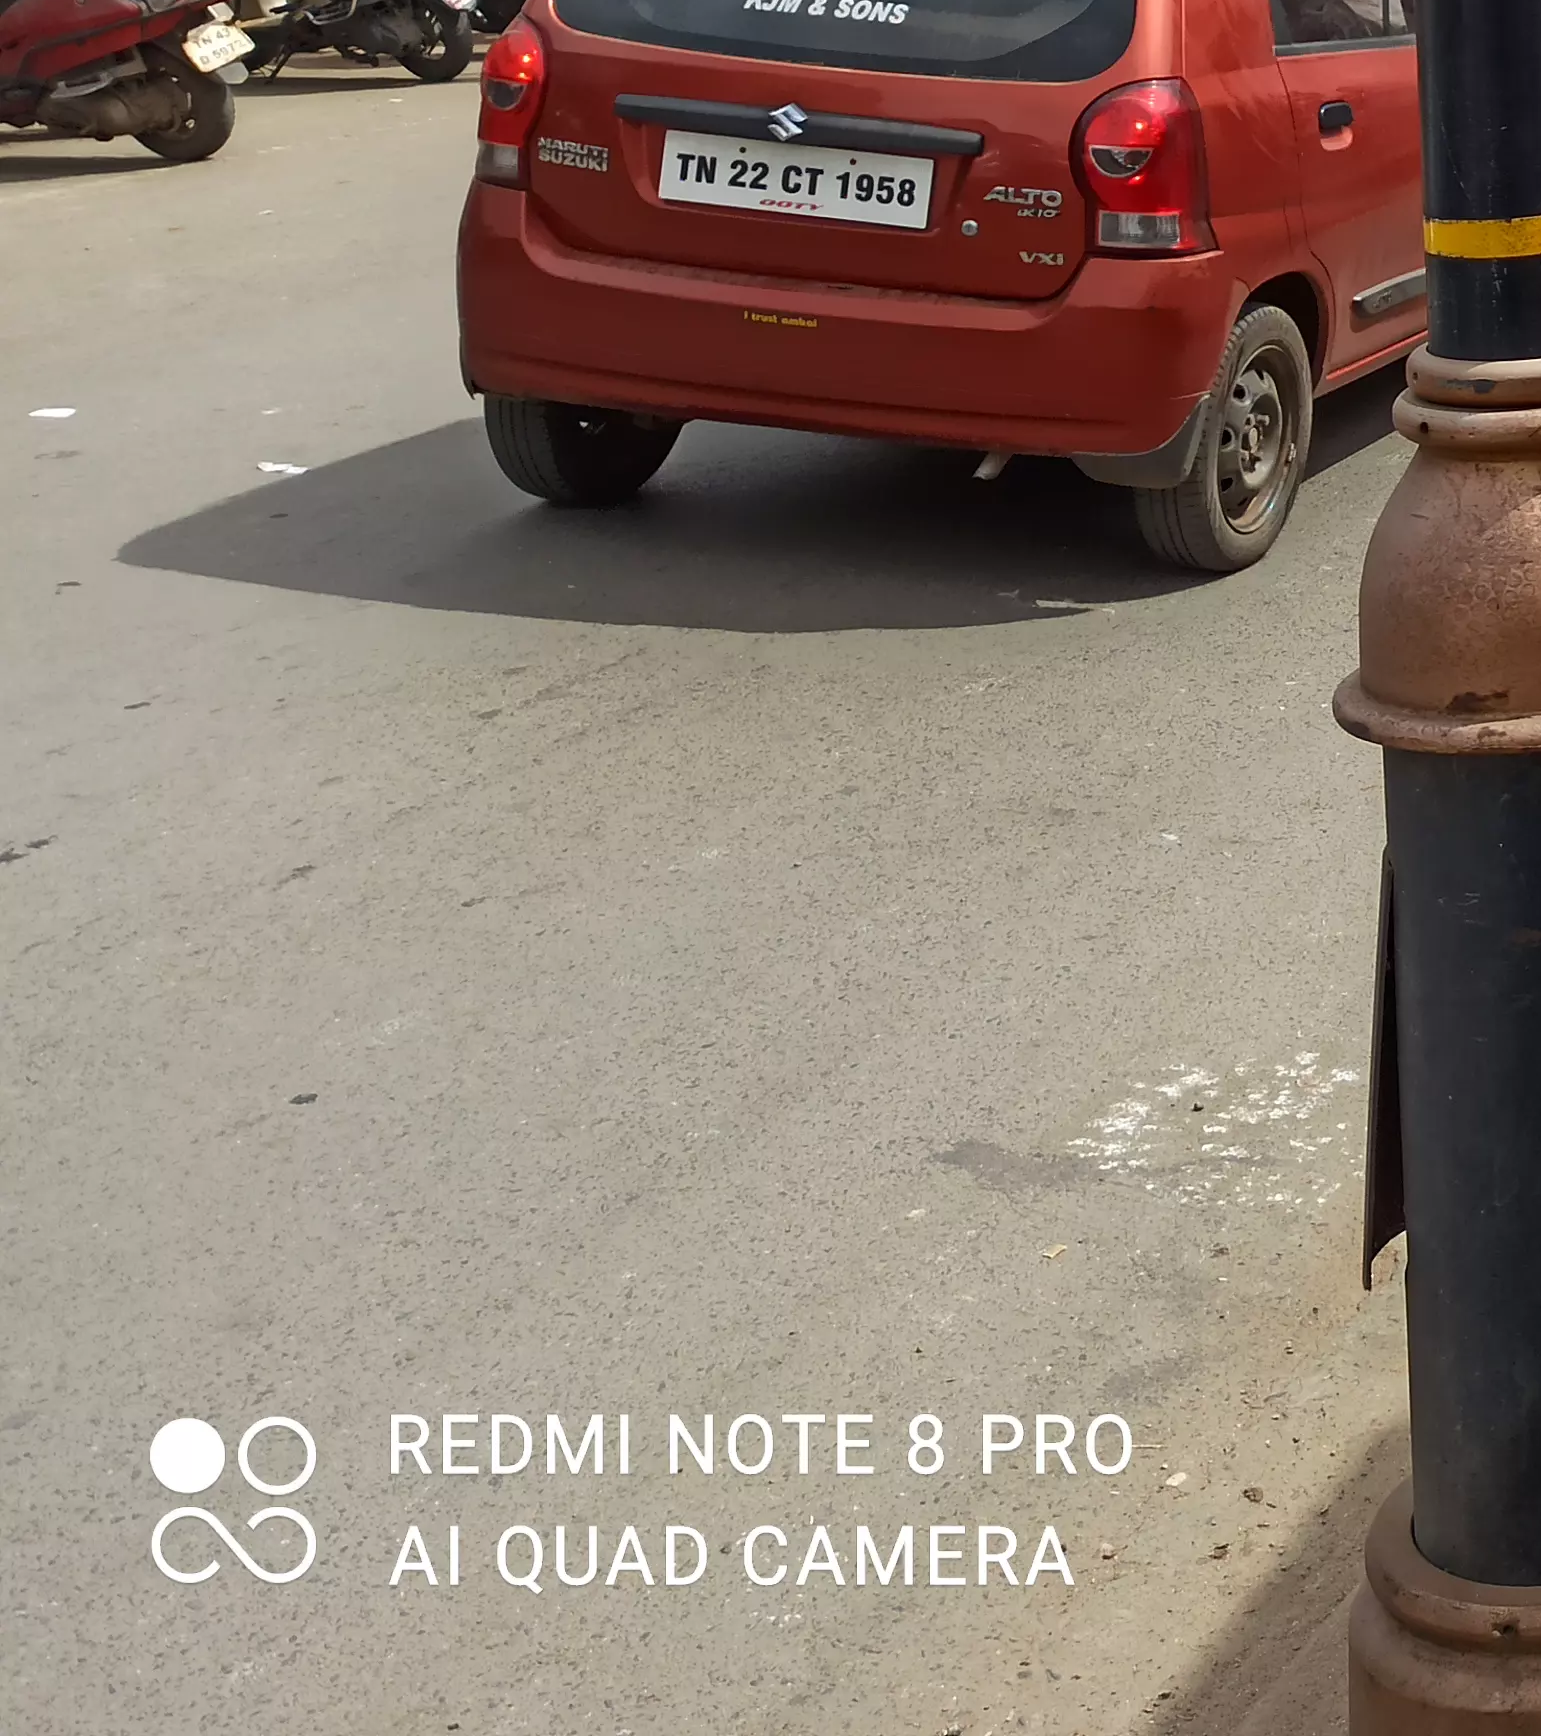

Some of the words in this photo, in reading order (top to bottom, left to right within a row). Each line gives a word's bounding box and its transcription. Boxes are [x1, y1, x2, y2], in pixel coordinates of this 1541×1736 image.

[192, 35, 213, 49] TN
[215, 27, 232, 40] 43
[538, 137, 610, 159] MARUTI
[537, 150, 610, 172] SUZUKI
[676, 153, 718, 185] TN
[727, 159, 768, 190] 22
[780, 165, 825, 197] CT
[835, 171, 917, 208] 1958
[759, 197, 825, 212] OOTY
[983, 184, 1064, 208] ALTO
[750, 313, 778, 325] trust
